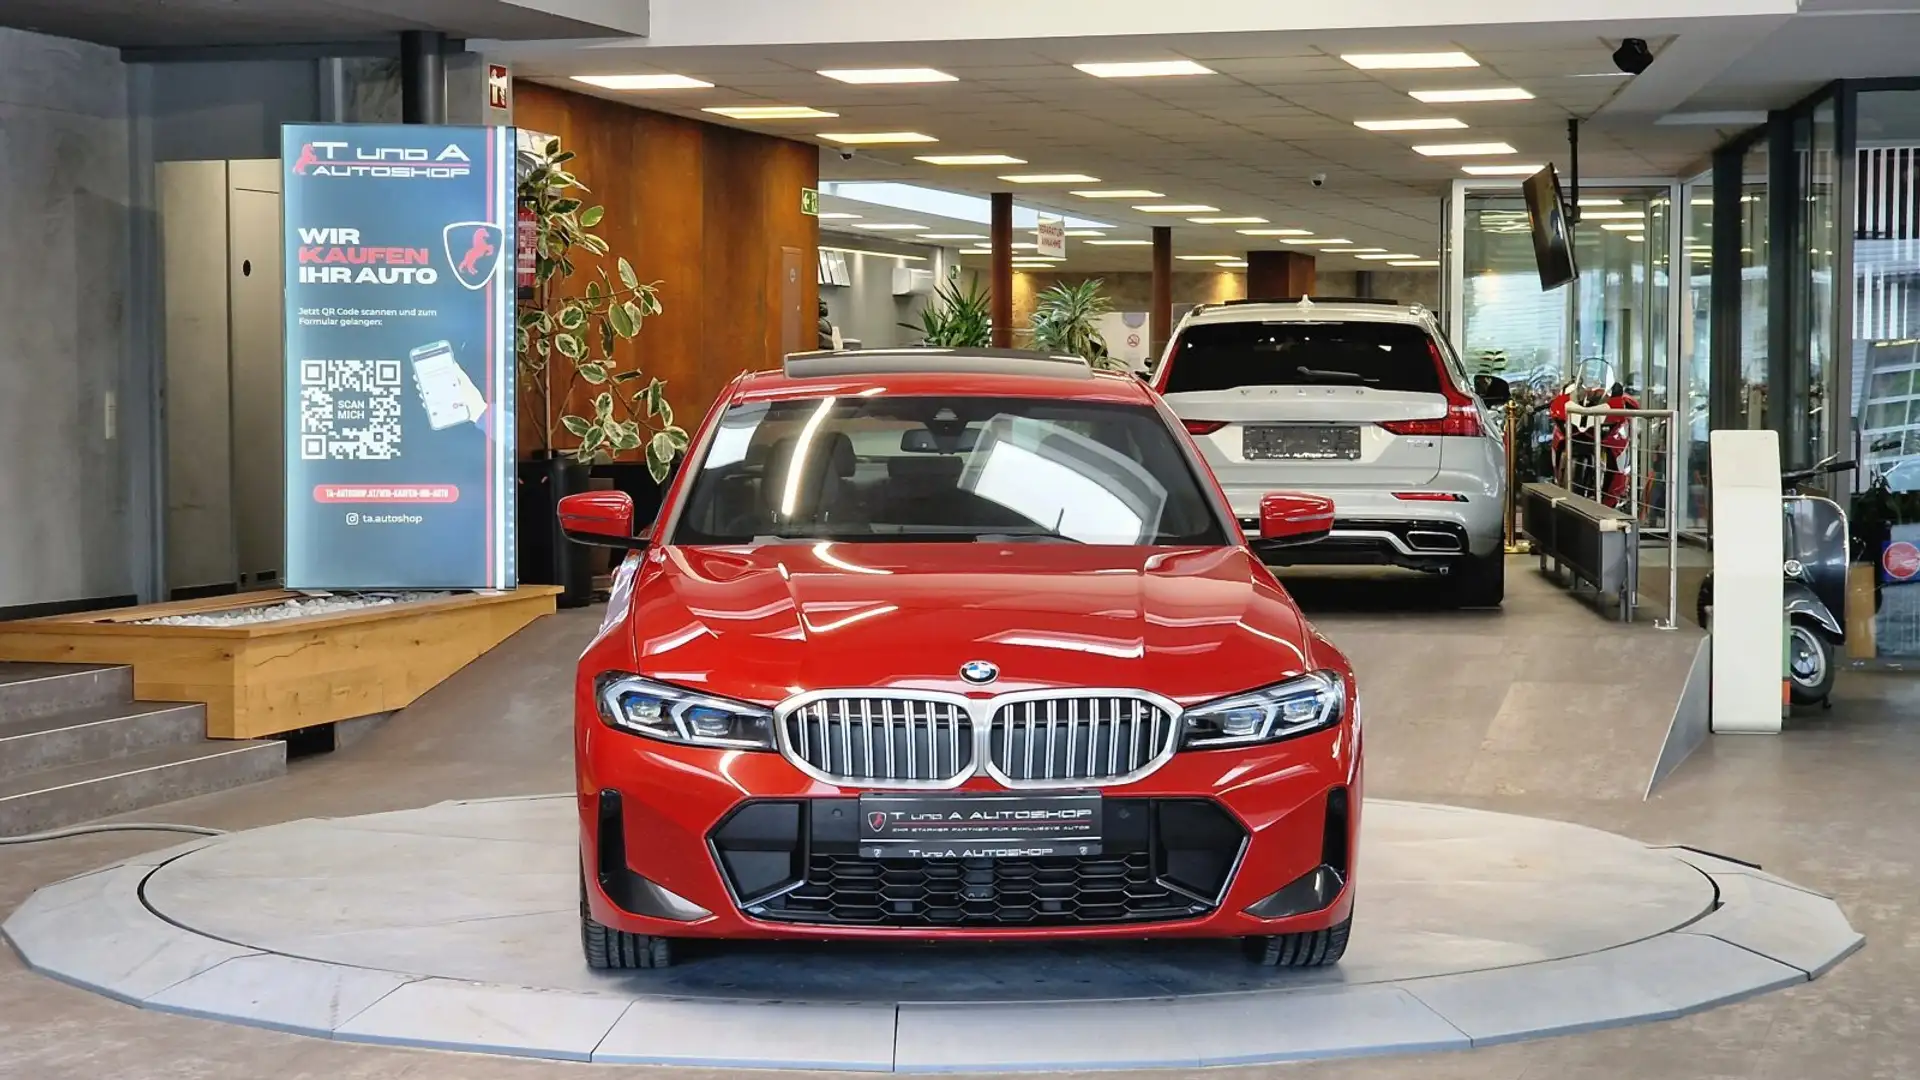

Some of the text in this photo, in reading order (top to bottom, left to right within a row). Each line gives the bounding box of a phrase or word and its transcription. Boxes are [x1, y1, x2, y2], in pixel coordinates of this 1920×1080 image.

[312, 142, 348, 159] T
[435, 144, 471, 161] A
[312, 166, 470, 178] AUTOSHOP
[298, 228, 360, 244] WIR
[299, 247, 429, 264] KAUFEN
[299, 267, 438, 284] IHR AUTO
[298, 308, 320, 316] Jetzt
[321, 308, 335, 317] QR
[336, 308, 359, 316] Code
[340, 318, 383, 327] gelangen:
[337, 400, 365, 409] SCAN
[337, 410, 365, 419] MICH
[362, 514, 423, 524] ta.autoshop
[890, 811, 905, 820] T
[948, 811, 963, 820] A
[969, 809, 1092, 820] AUTOSHOP
[963, 848, 1053, 857] AUTOSHOP
